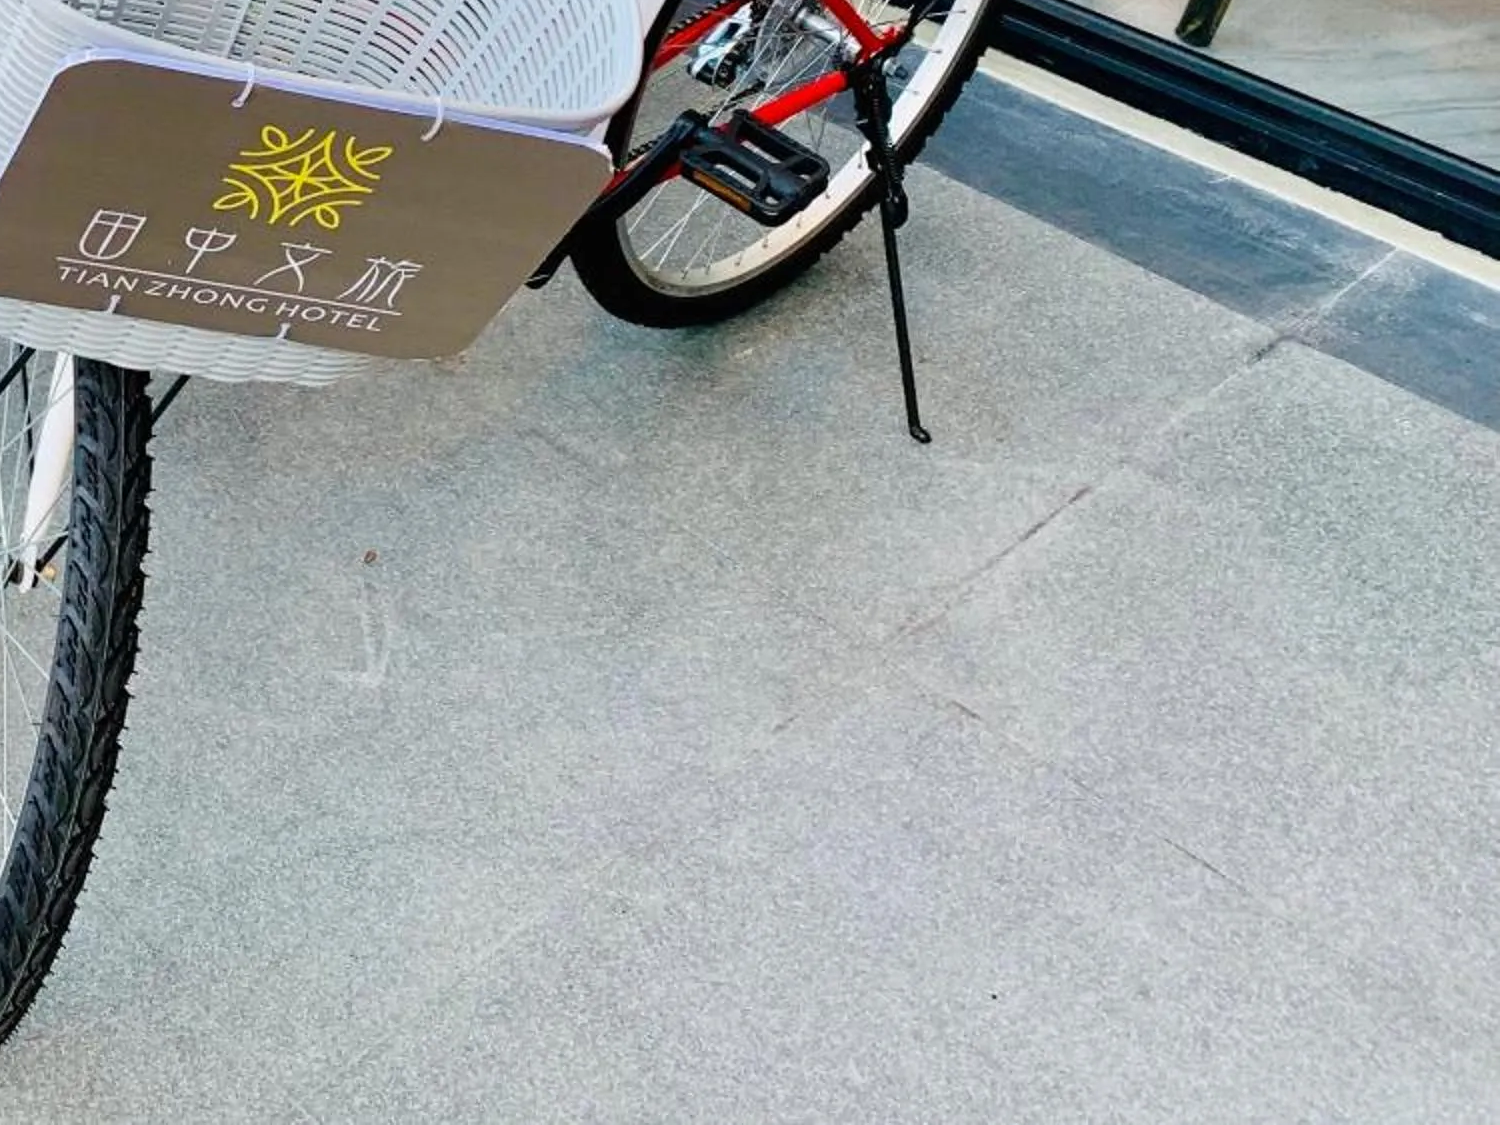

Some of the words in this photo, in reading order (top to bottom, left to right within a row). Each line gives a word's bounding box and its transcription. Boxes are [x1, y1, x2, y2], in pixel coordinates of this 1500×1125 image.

[58, 266, 139, 292] TIAN
[143, 281, 267, 313] ZHONG
[274, 301, 382, 332] HOTEL
